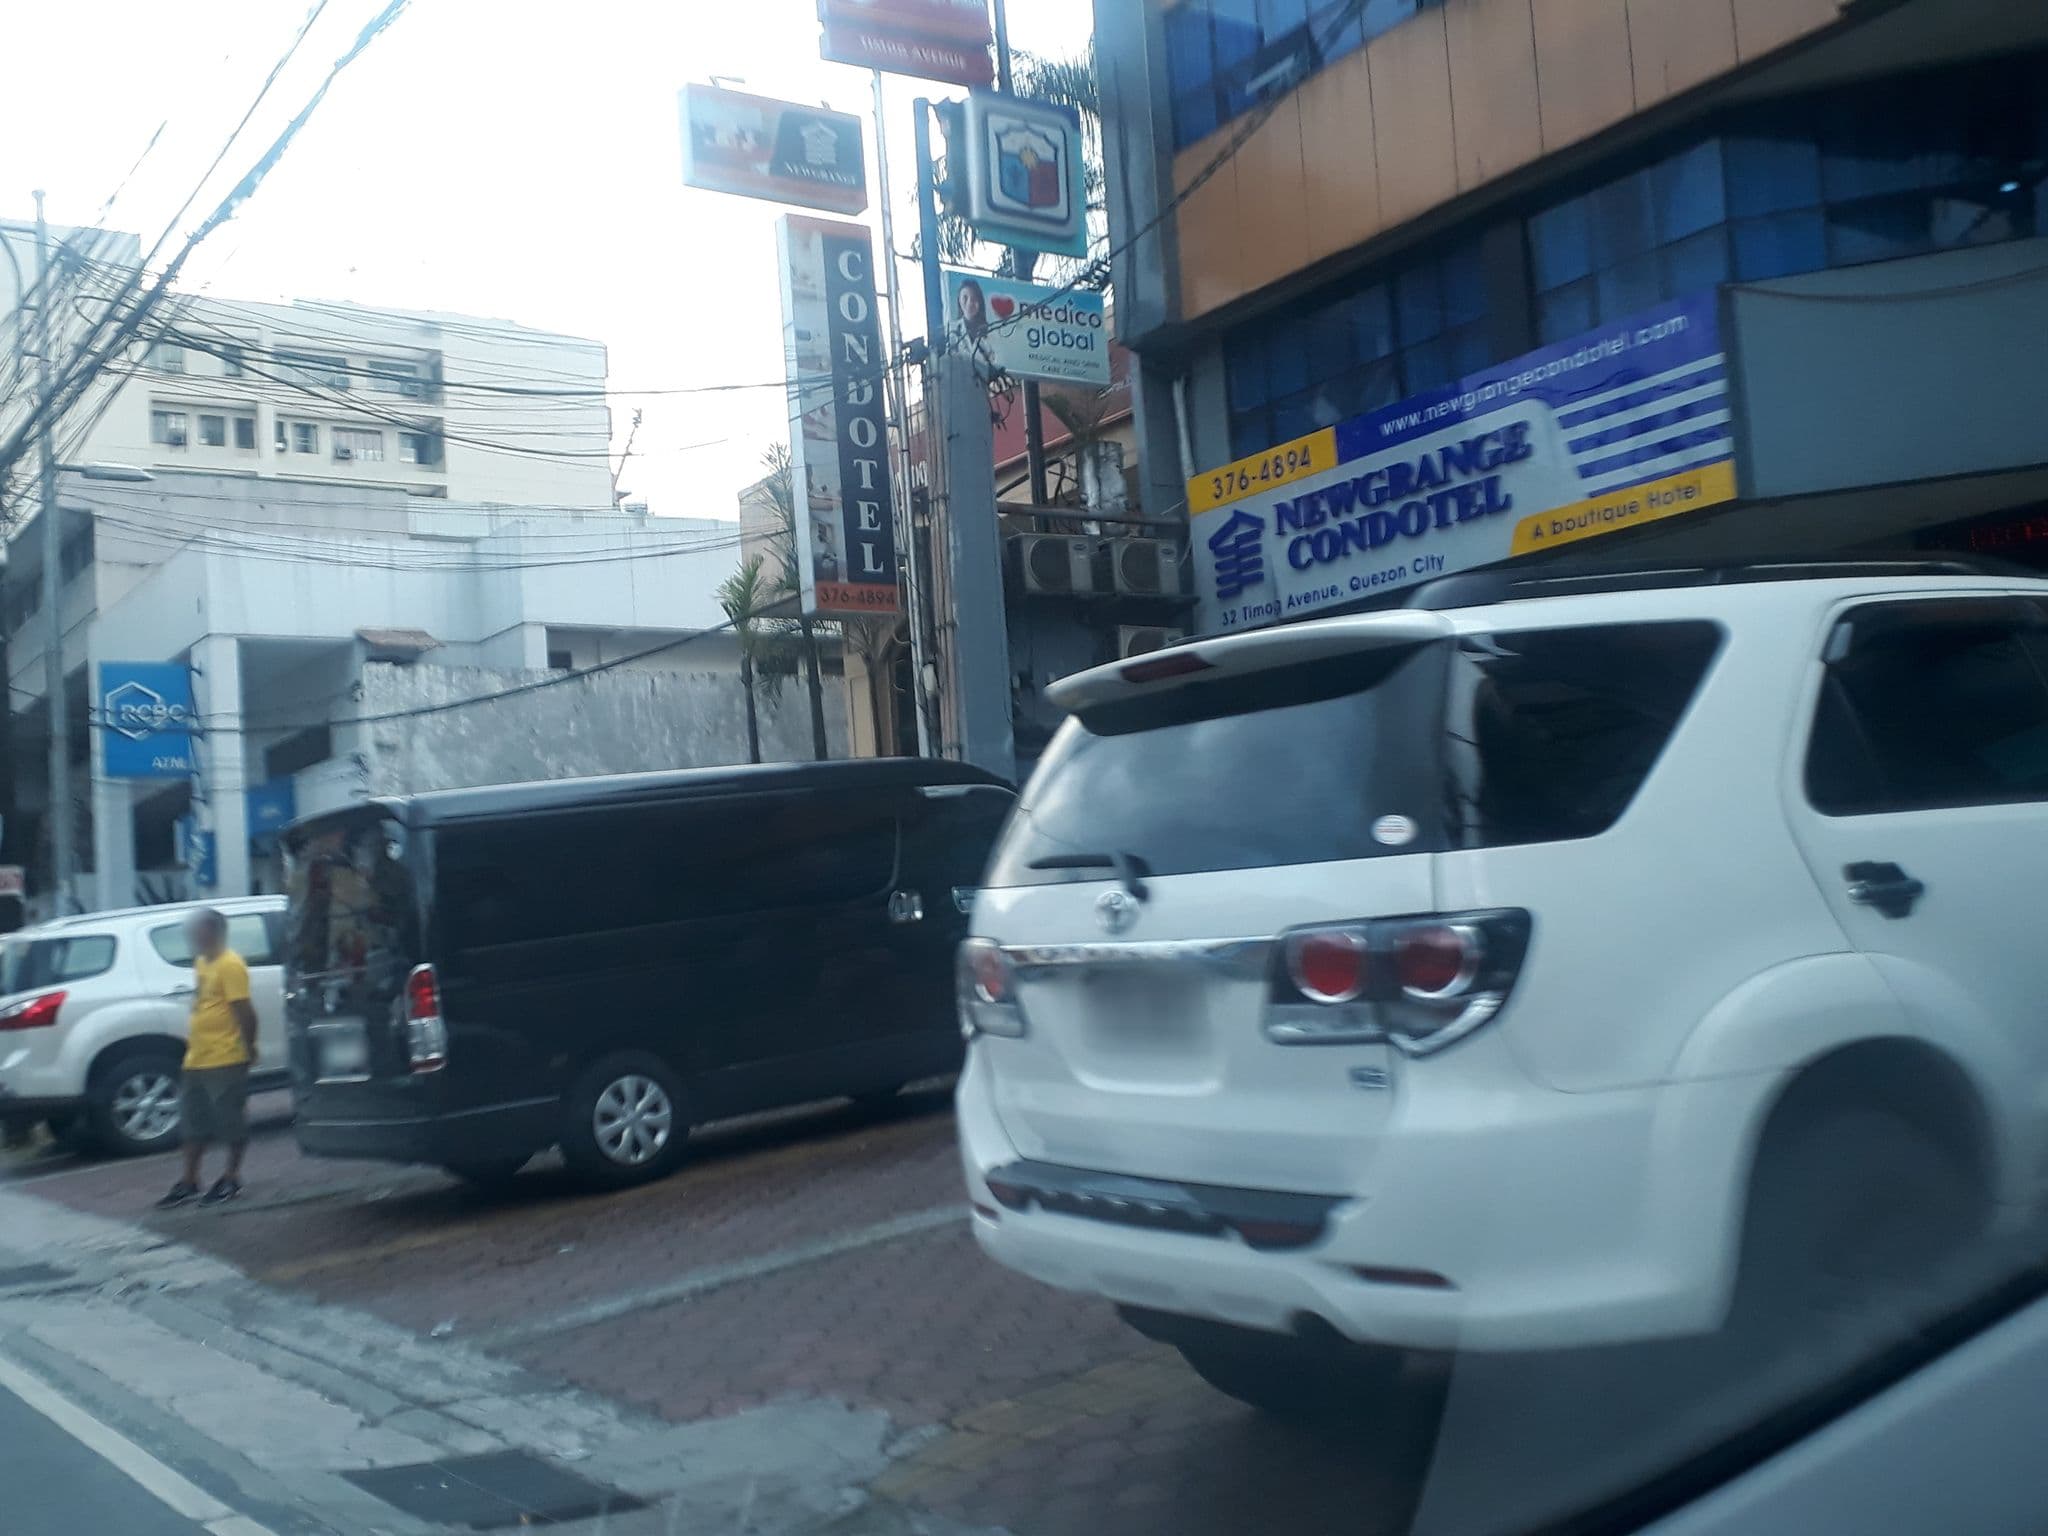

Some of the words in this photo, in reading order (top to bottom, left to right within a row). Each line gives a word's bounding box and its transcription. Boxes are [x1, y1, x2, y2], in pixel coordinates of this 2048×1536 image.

[1019, 298, 1102, 328] medico
[1027, 325, 1095, 352] global
[837, 250, 885, 574] CONDOTEL
[1212, 445, 1312, 500] 376-4894
[1273, 420, 1534, 536] NEWGRANGE
[1288, 475, 1513, 570] CONDOTEL
[1533, 523, 1545, 540] A
[1551, 500, 1640, 535] boutique
[1647, 483, 1702, 508] Hotel
[1287, 585, 1344, 609] Avenue,
[1350, 565, 1408, 592] Quezon
[1413, 554, 1446, 574] City
